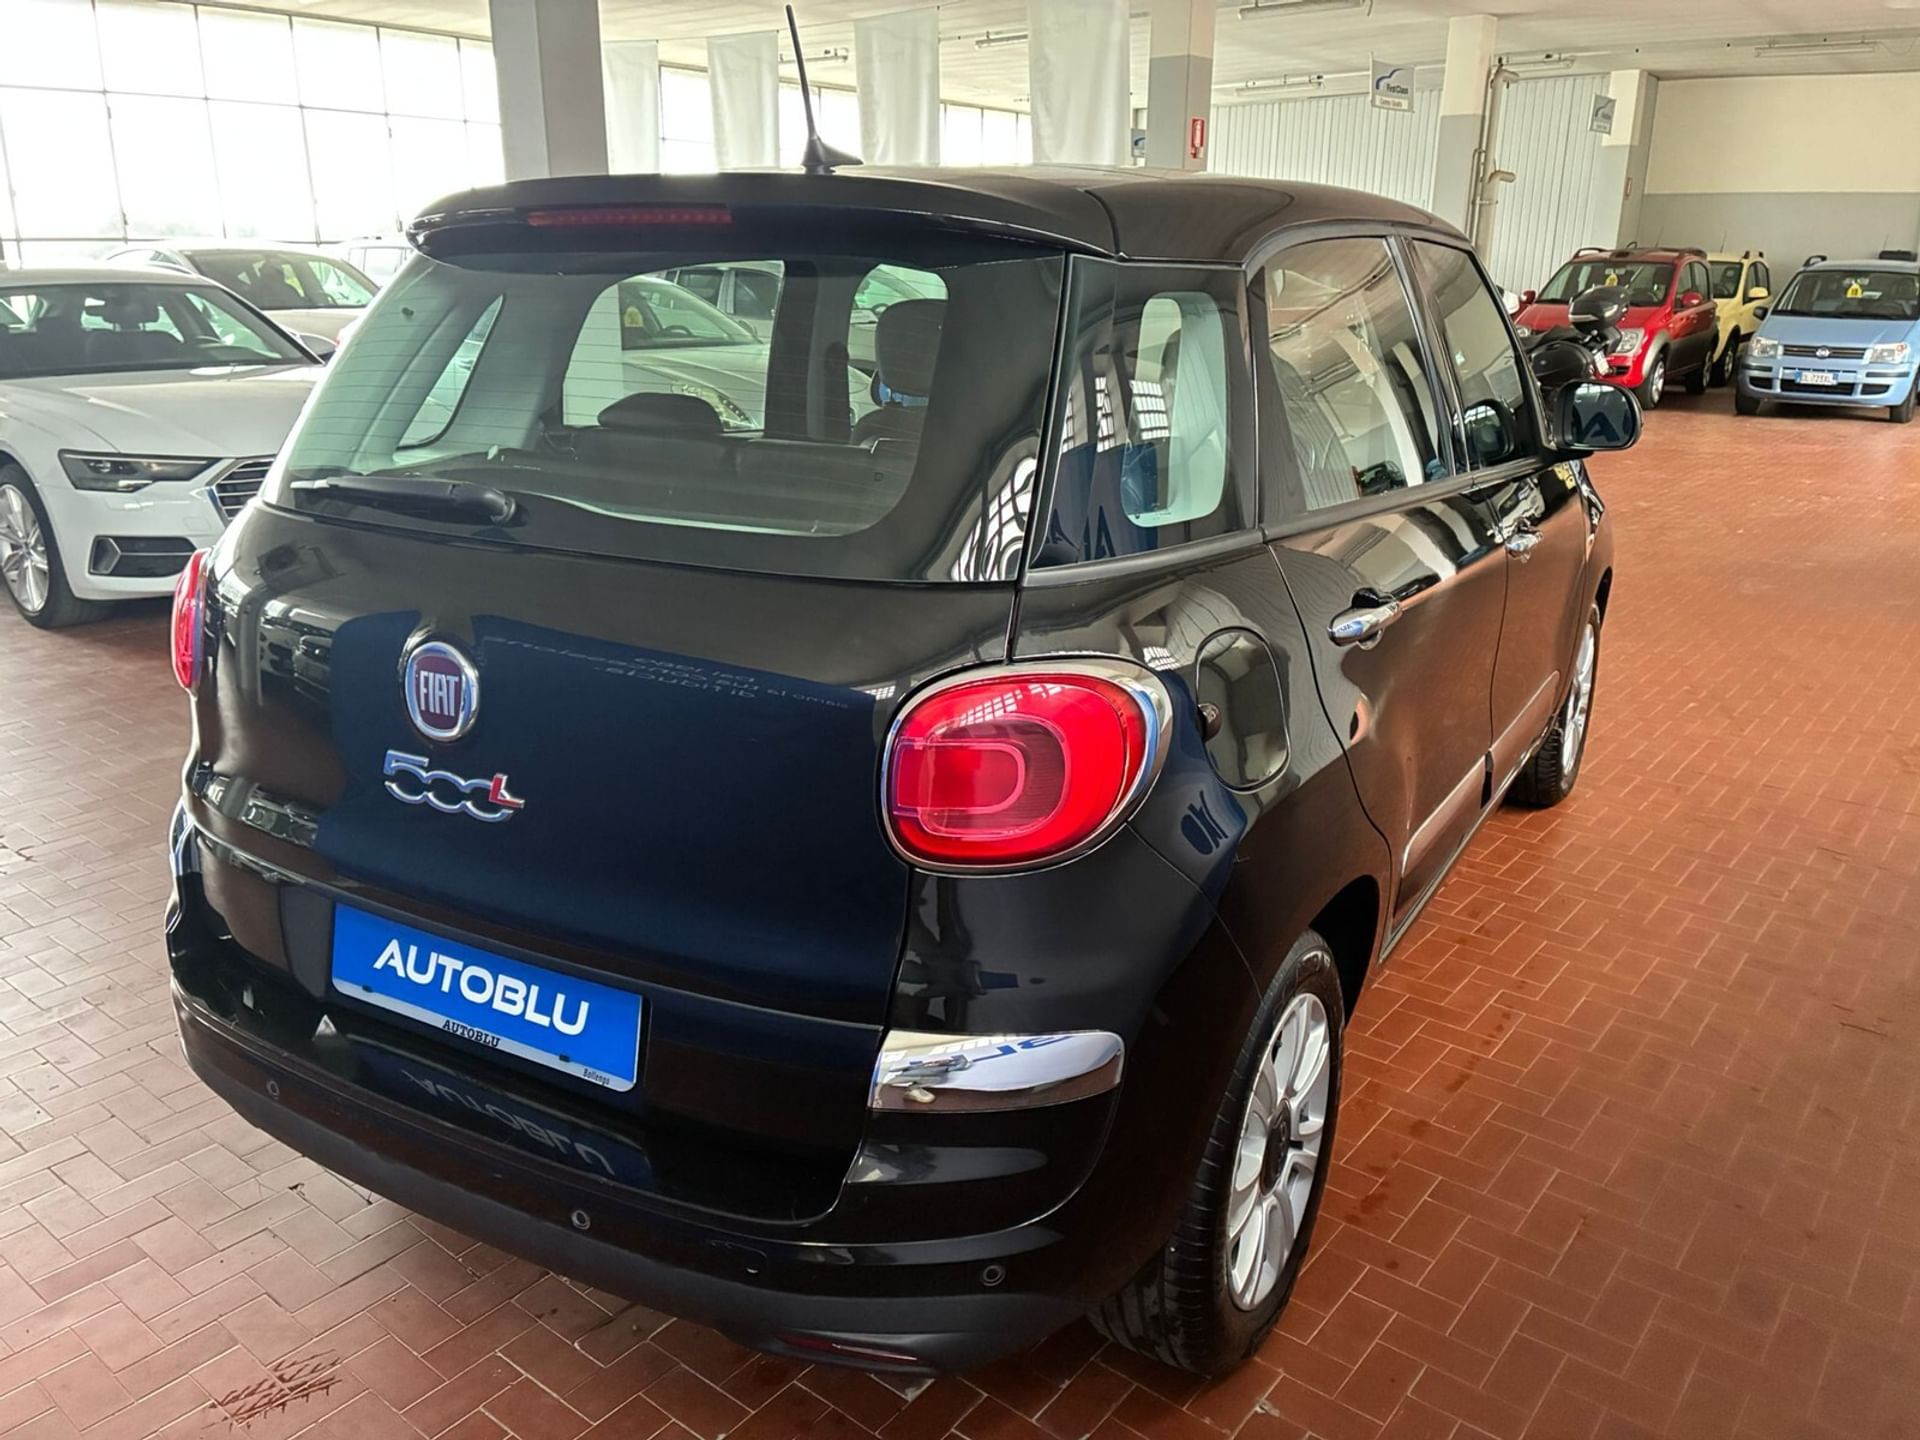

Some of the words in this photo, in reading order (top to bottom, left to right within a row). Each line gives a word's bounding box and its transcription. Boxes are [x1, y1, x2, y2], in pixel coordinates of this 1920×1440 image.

[419, 669, 460, 717] FIAT
[383, 750, 526, 823] 500L
[372, 938, 590, 1036] AUTOBLU
[442, 1019, 501, 1048] AUTOBLU
